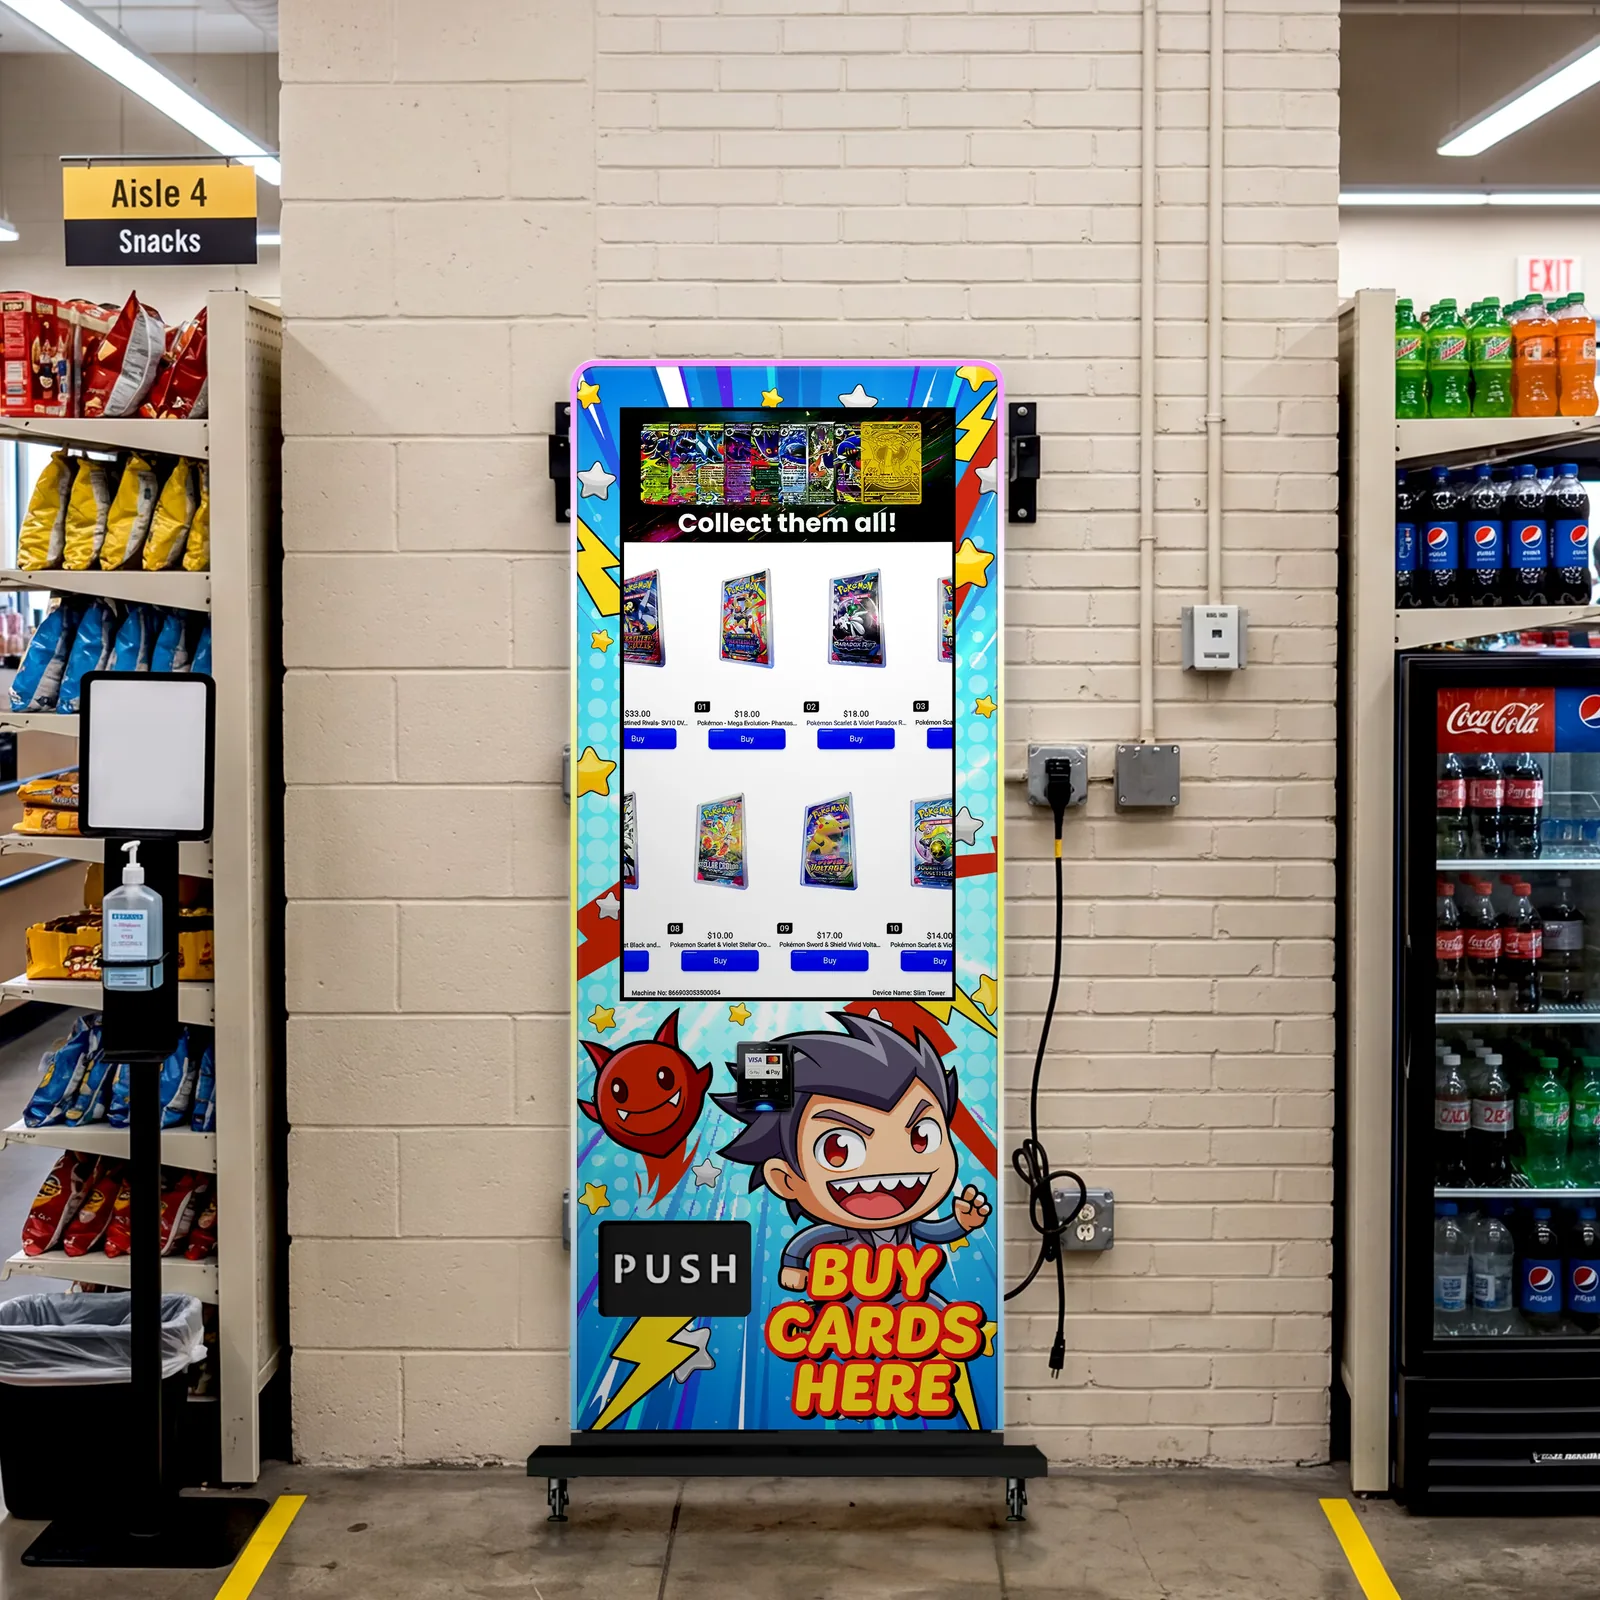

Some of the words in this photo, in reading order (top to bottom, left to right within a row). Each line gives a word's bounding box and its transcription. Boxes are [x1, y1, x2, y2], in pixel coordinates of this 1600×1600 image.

[111, 178, 180, 208] Aisle
[190, 177, 207, 207] 4
[119, 228, 201, 254] Snacks
[1529, 259, 1574, 292] EXIT
[678, 512, 772, 533] Collect
[778, 512, 849, 533] them
[855, 512, 897, 533] all!
[697, 703, 706, 711] 01
[806, 703, 817, 711] 02
[915, 702, 926, 710] 03
[624, 709, 651, 718] $33.00
[734, 709, 760, 718] $18.00
[843, 709, 870, 718] $18.00
[915, 718, 942, 726] Pokémon
[1446, 702, 1545, 735] Coca-Cola
[727, 720, 743, 728] Mega
[631, 734, 645, 744] Buy
[740, 735, 755, 744] Buy
[849, 735, 864, 744] Buy
[670, 924, 680, 932] 08
[780, 924, 790, 932] 09
[890, 924, 900, 932] 10
[707, 931, 734, 940] $10.00
[816, 931, 843, 940] $17.00
[926, 931, 953, 940] $14.00
[713, 956, 728, 966] Buy
[823, 956, 837, 966] Buy
[933, 957, 948, 967] Buy
[631, 989, 656, 997] Machine
[657, 989, 668, 997] No:
[770, 1069, 781, 1077] Pay
[613, 1252, 738, 1285] PUSH
[808, 1245, 944, 1300] BUY
[767, 1303, 982, 1359] CARDS
[792, 1361, 957, 1415] HERE
